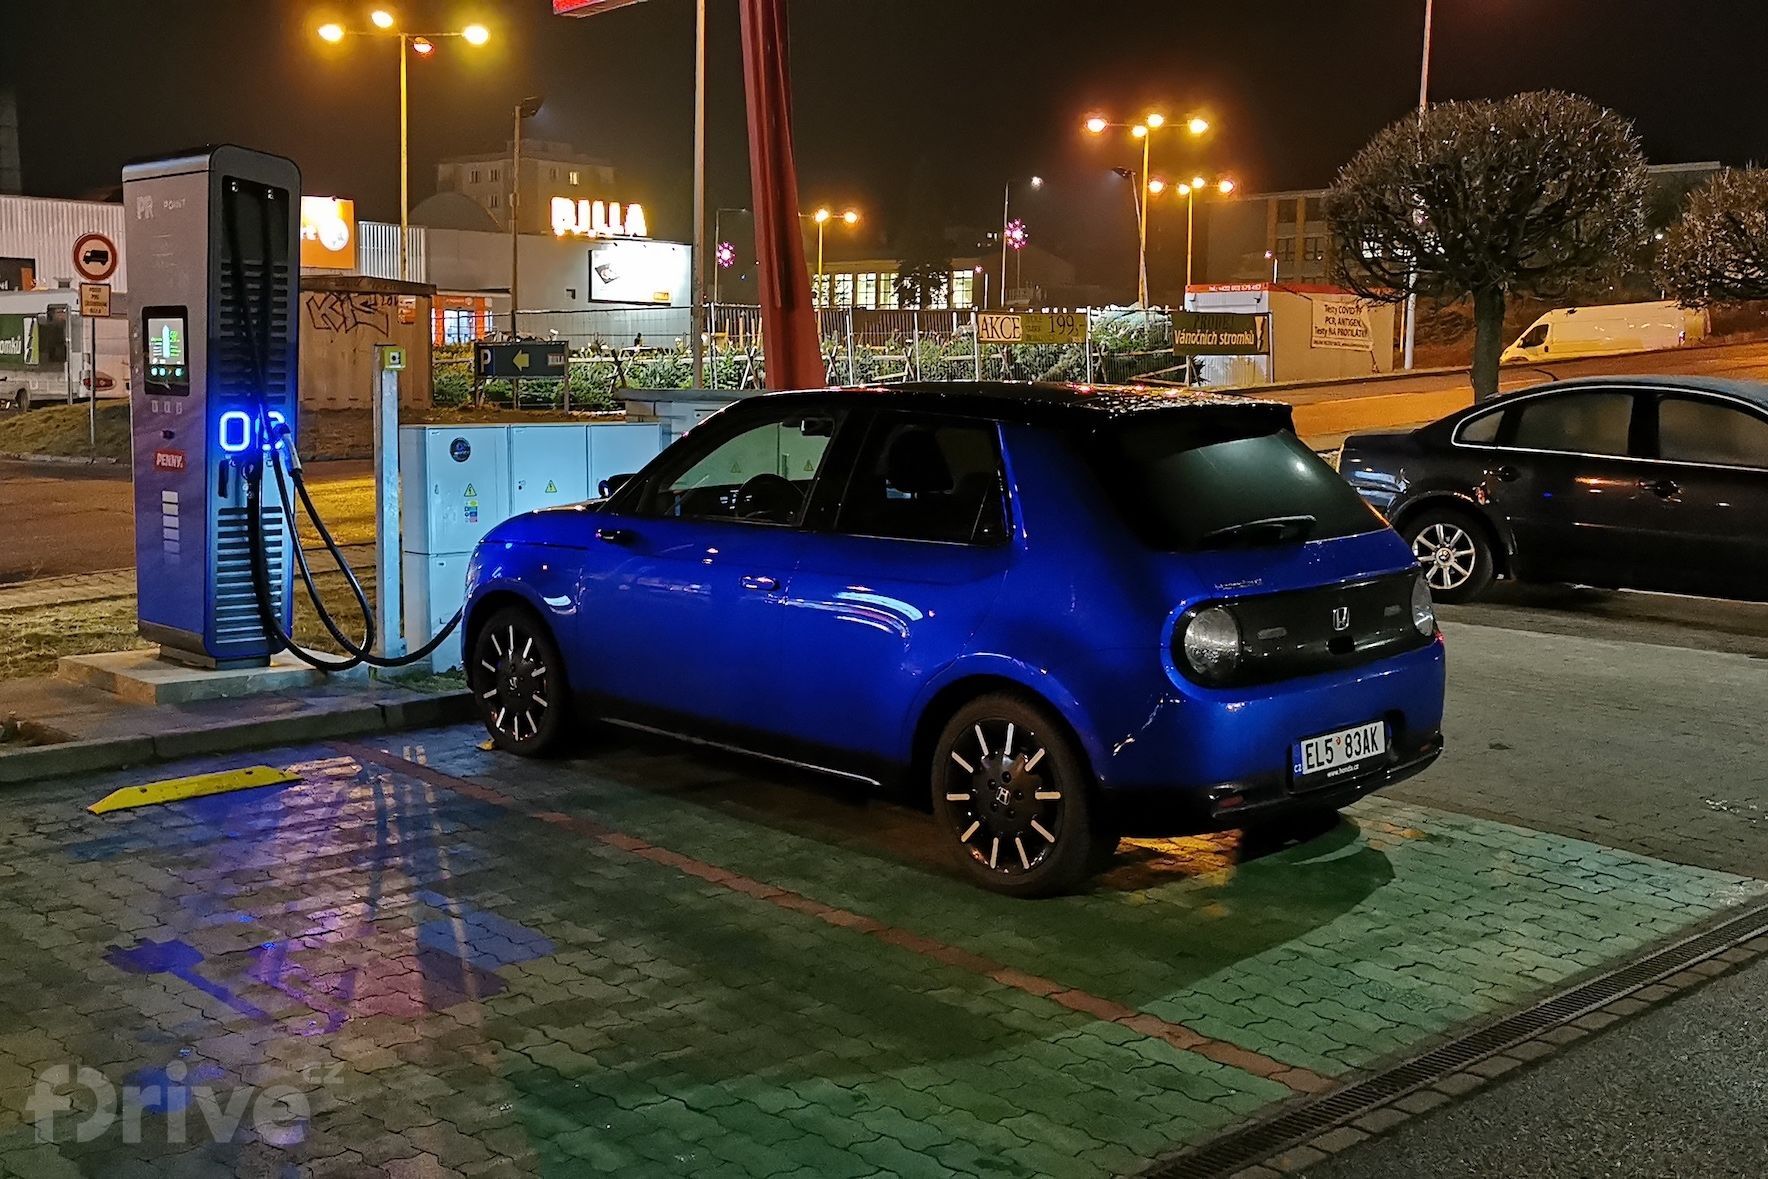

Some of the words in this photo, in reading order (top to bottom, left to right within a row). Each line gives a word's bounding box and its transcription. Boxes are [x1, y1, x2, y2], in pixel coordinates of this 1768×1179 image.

[1324, 304, 1338, 315] Testy
[979, 316, 1022, 340] AKCE
[1174, 328, 1218, 345] Vánočních
[1219, 330, 1255, 345] stromků
[1314, 326, 1328, 338] Testy
[481, 349, 492, 373] P
[1305, 738, 1334, 770] EL5
[1344, 725, 1379, 759] 83AK
[1293, 763, 1303, 773] CZ
